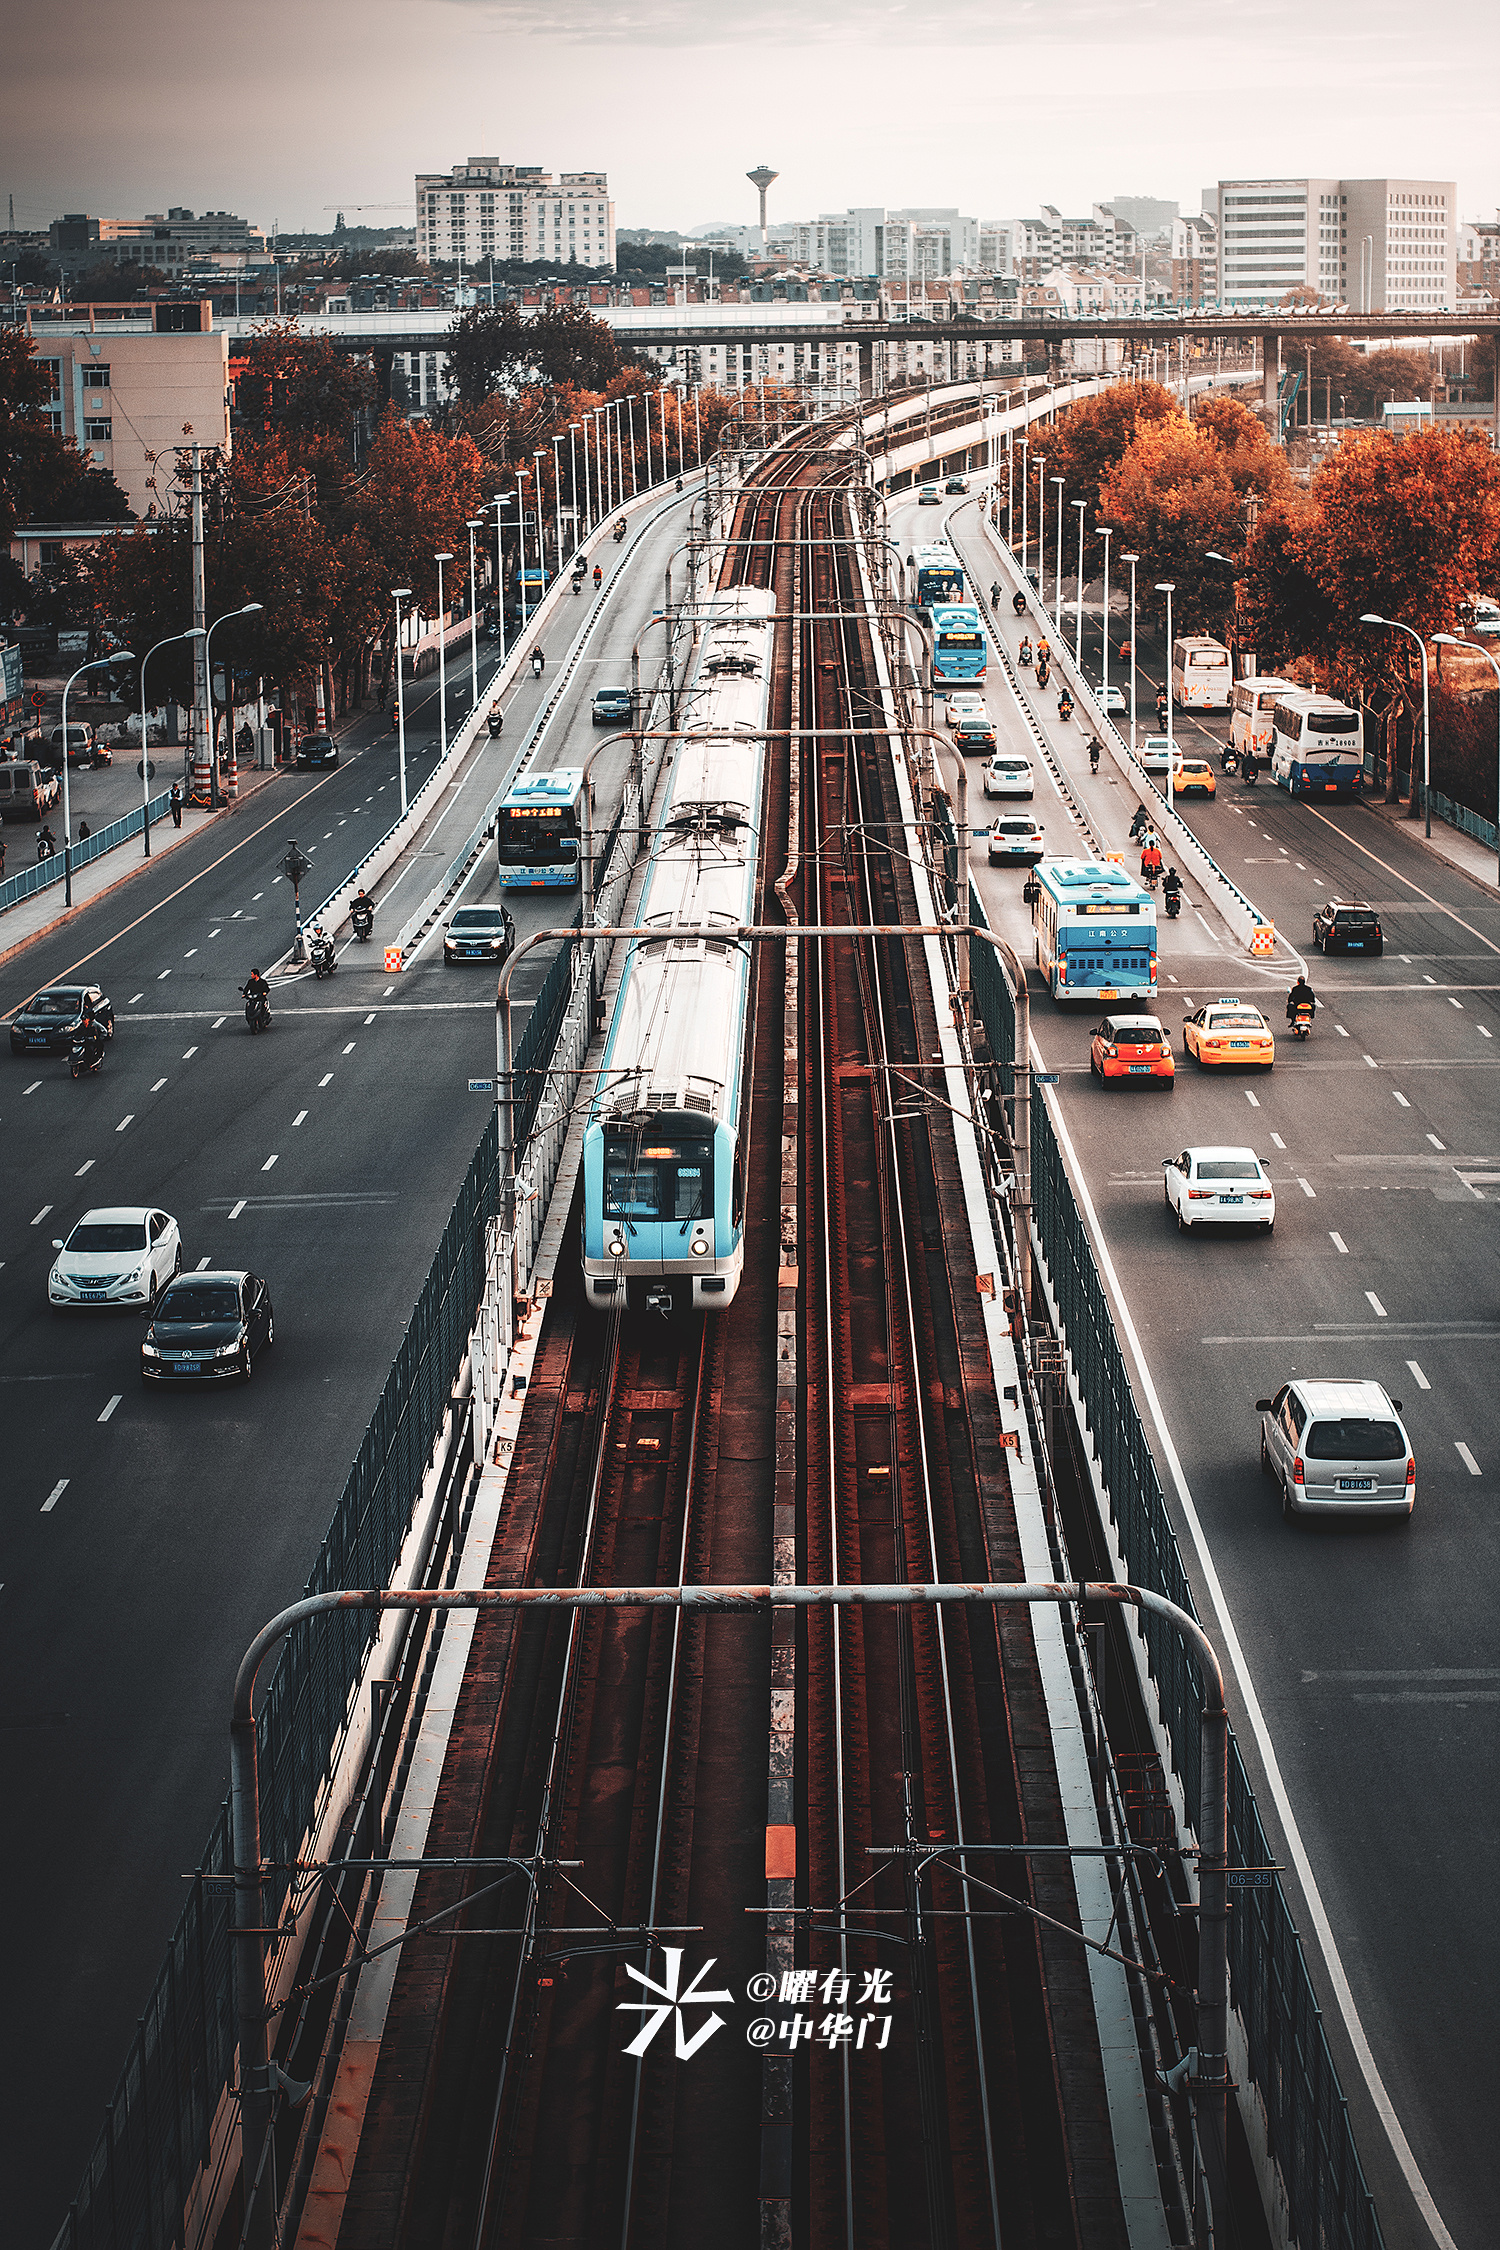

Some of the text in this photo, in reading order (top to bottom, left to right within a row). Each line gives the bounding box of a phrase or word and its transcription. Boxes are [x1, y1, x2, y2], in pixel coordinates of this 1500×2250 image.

[510, 808, 521, 817] 75
[1088, 929, 1129, 938] 江南公交
[1002, 1436, 1014, 1446] K5
[500, 1442, 512, 1452] K5
[1229, 1873, 1270, 1886] 06-35
[207, 1883, 236, 1895] 06-3
